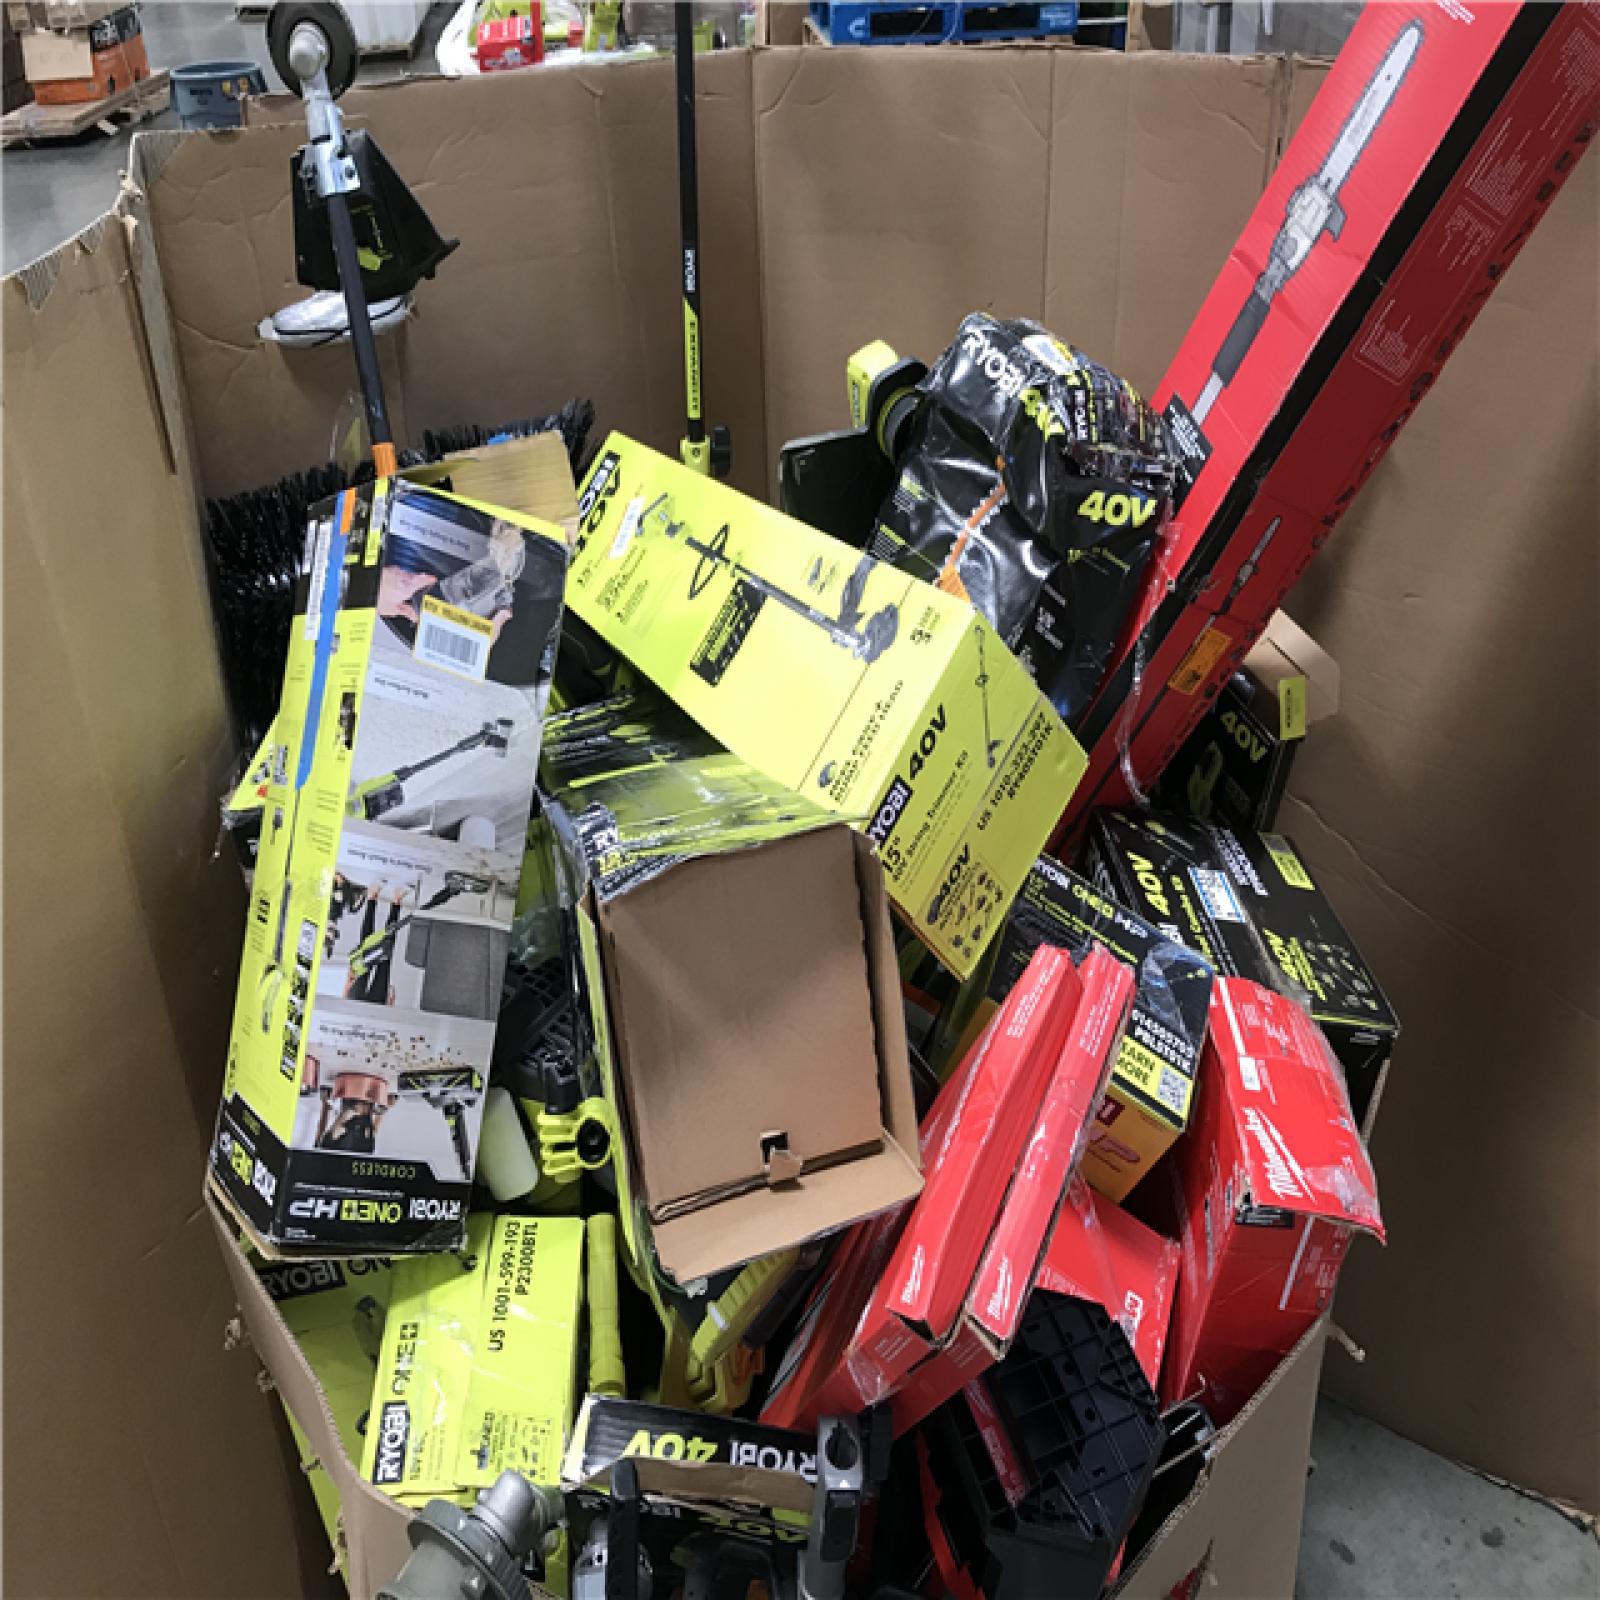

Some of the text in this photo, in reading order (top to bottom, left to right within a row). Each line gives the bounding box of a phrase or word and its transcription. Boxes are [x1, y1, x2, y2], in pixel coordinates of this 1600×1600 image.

[964, 331, 1026, 398] RYOBI
[1078, 491, 1158, 527] 40V
[909, 702, 947, 781] 40V
[1216, 714, 1269, 764] 40V
[1125, 851, 1169, 915] 40V
[1262, 928, 1299, 980] 40V
[349, 1160, 416, 1178] CORDLESS
[1239, 1106, 1304, 1200] Milwaukee
[287, 1195, 460, 1221] RYOBI ONE+ HP
[488, 1220, 520, 1351] US 1001-599-193
[516, 1221, 538, 1295] P2300BTL
[376, 1321, 418, 1483] RYOBI ONE+
[621, 1428, 818, 1475] RYOBI 40V
